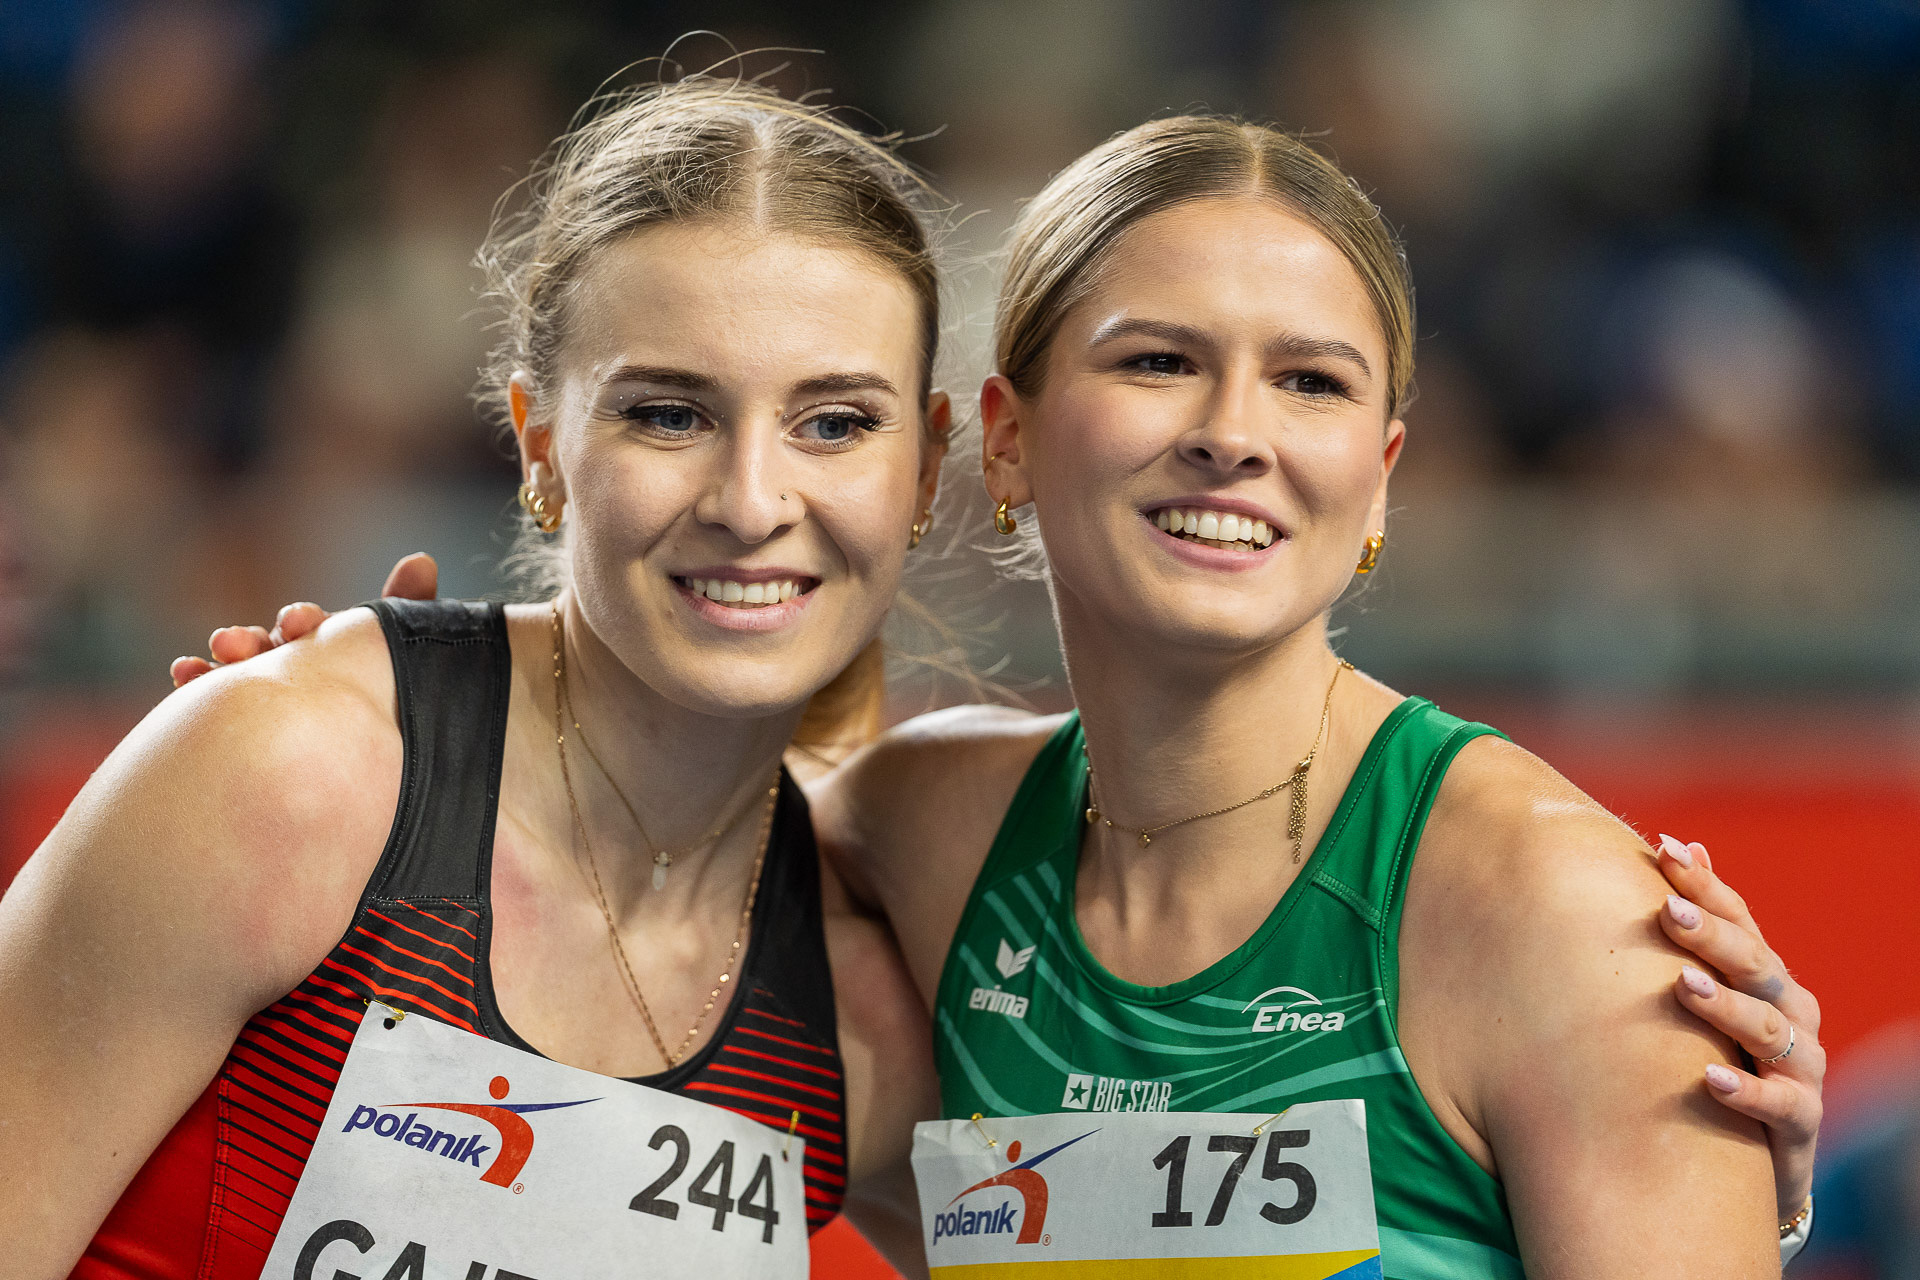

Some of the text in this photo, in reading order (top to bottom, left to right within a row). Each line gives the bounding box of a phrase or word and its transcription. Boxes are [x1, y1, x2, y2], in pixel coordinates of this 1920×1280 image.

[969, 984, 1029, 1018] erima
[1252, 1005, 1346, 1032] Enea
[1092, 1076, 1172, 1113] BIG STAR
[341, 1104, 491, 1168] polanik
[628, 1124, 779, 1245] 244
[1151, 1129, 1317, 1228] 175
[933, 1201, 1018, 1246] polanik
